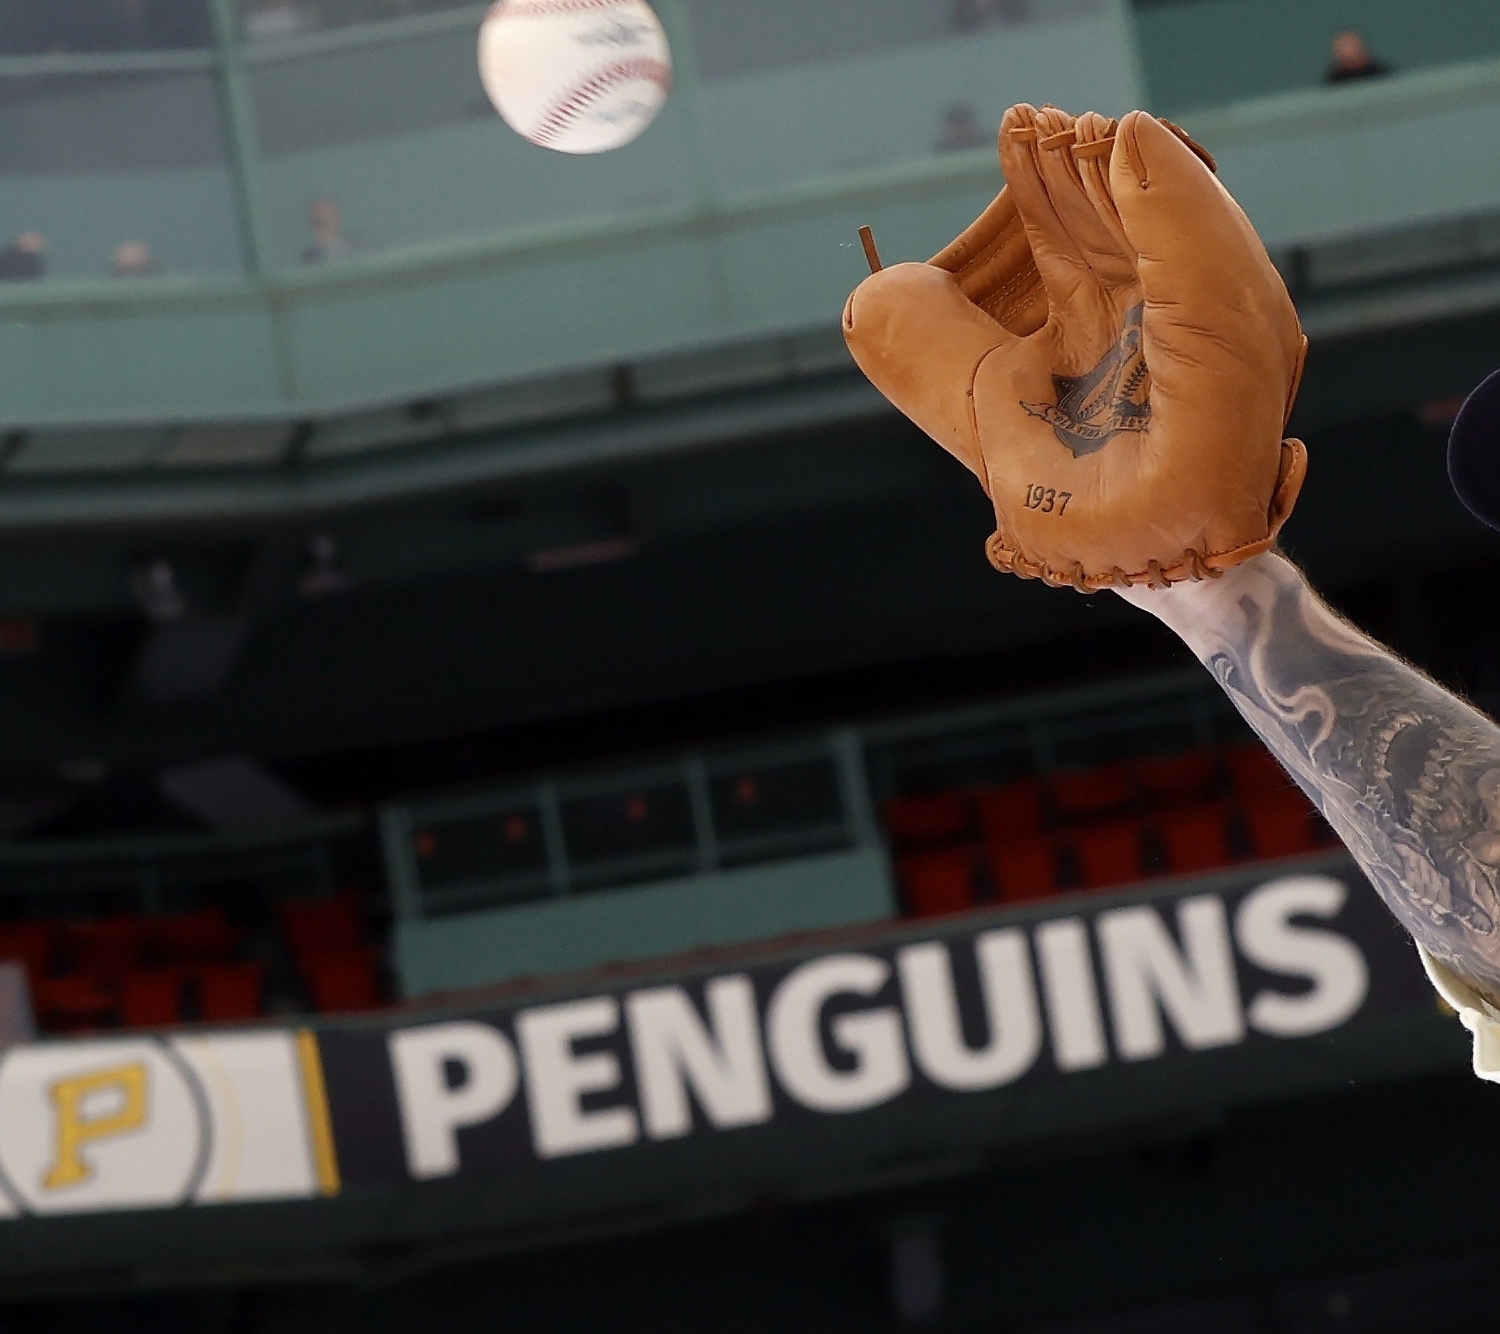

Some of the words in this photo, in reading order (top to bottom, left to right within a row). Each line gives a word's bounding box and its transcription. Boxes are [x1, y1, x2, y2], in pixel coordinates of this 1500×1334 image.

[1023, 483, 1072, 516] 1937
[388, 874, 1373, 1181] PENGUINS
[41, 1060, 151, 1192] P
